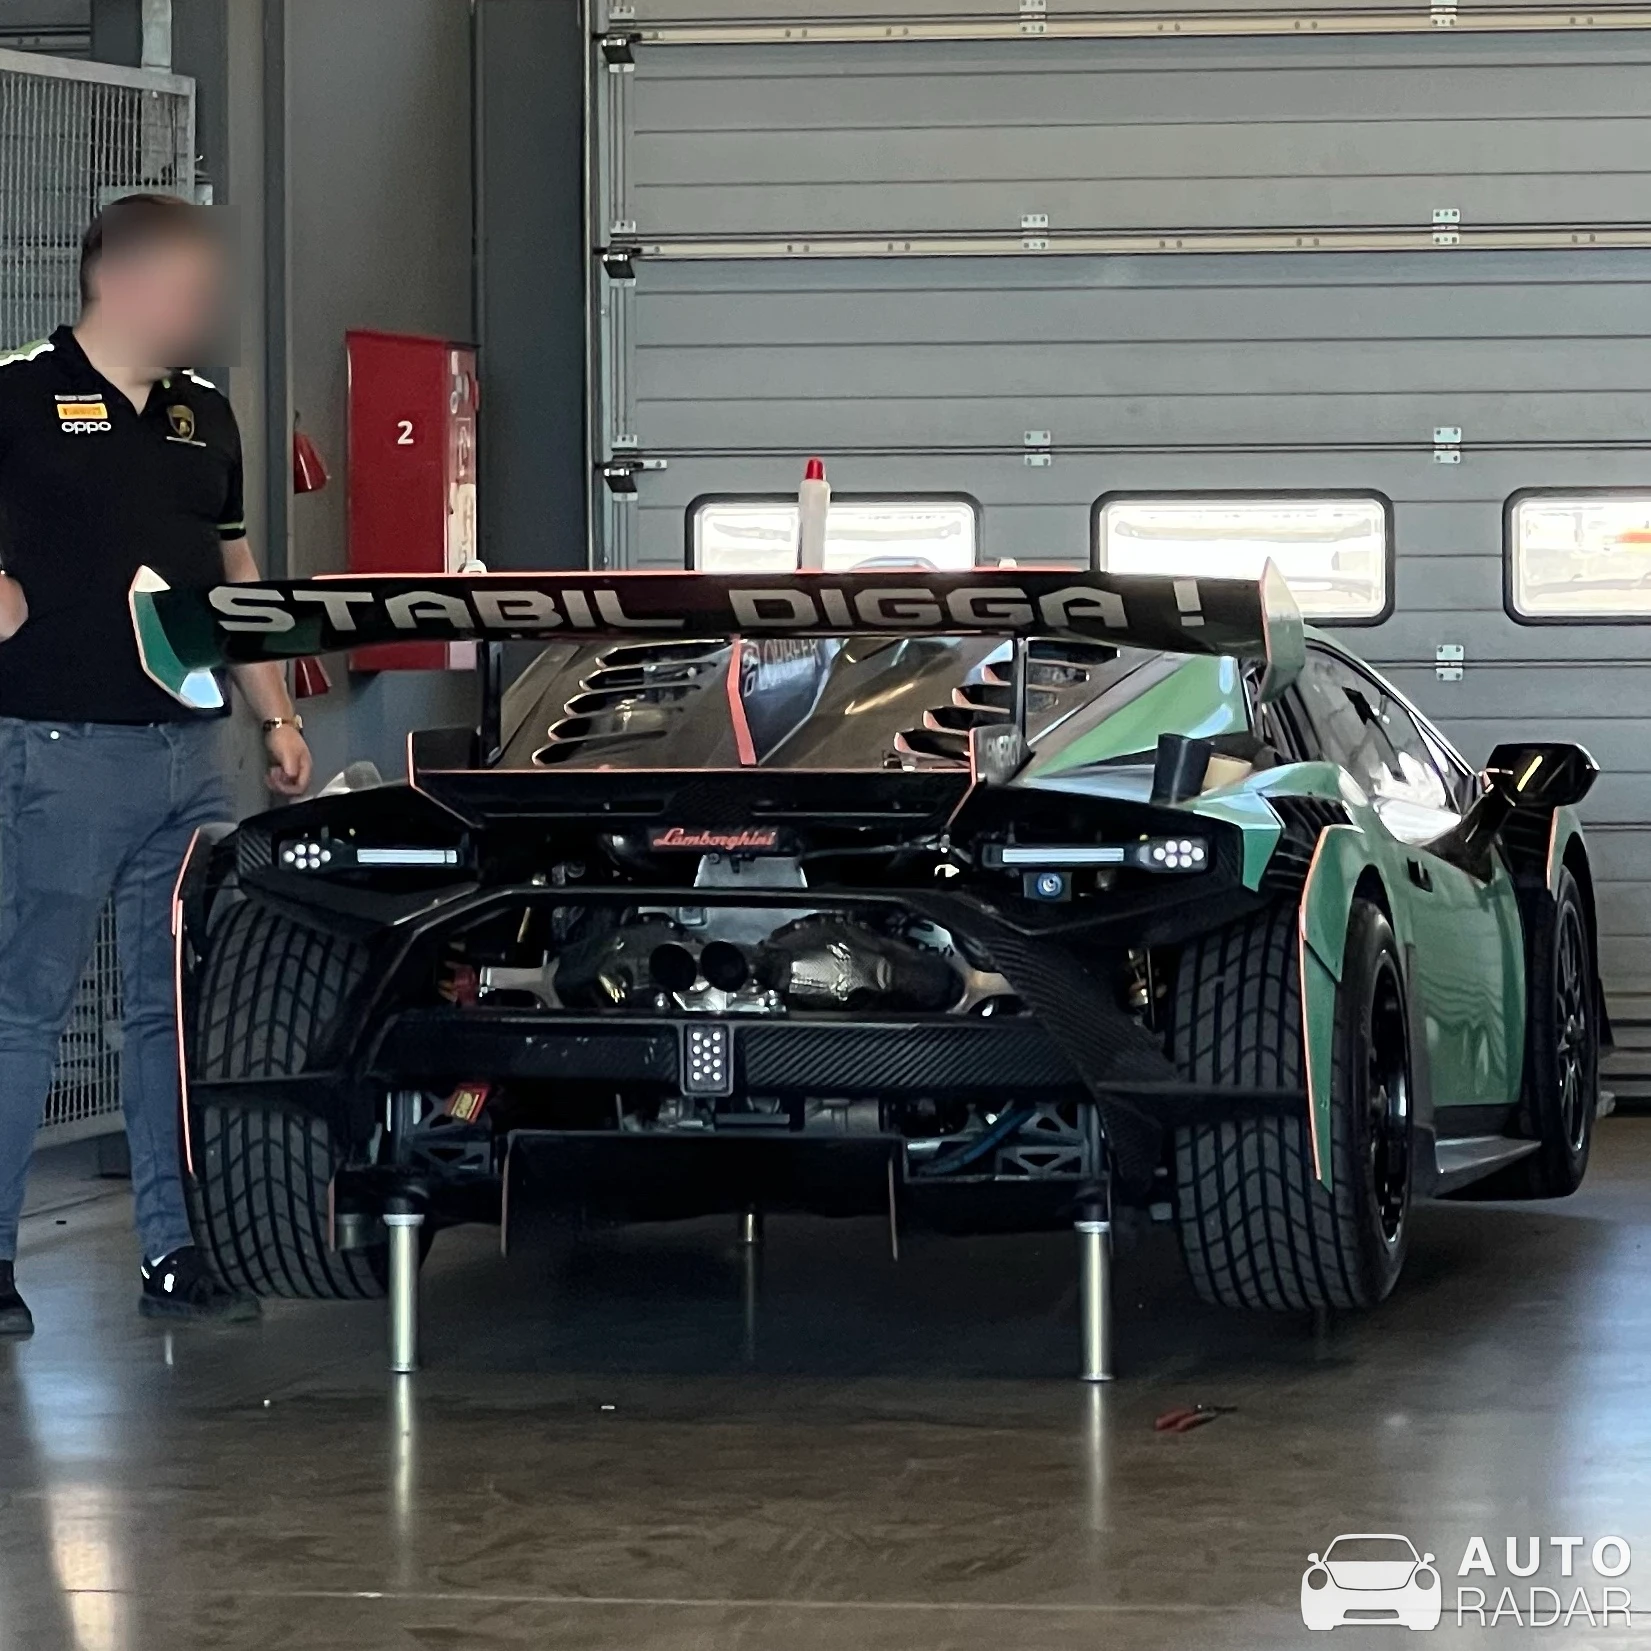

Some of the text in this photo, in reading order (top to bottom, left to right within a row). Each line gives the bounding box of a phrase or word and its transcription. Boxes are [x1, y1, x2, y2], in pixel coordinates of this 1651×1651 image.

[61, 421, 112, 435] oppo
[397, 420, 414, 444] 2
[207, 578, 1205, 633] STABIL DIGGA !
[653, 828, 777, 850] Lamborghini
